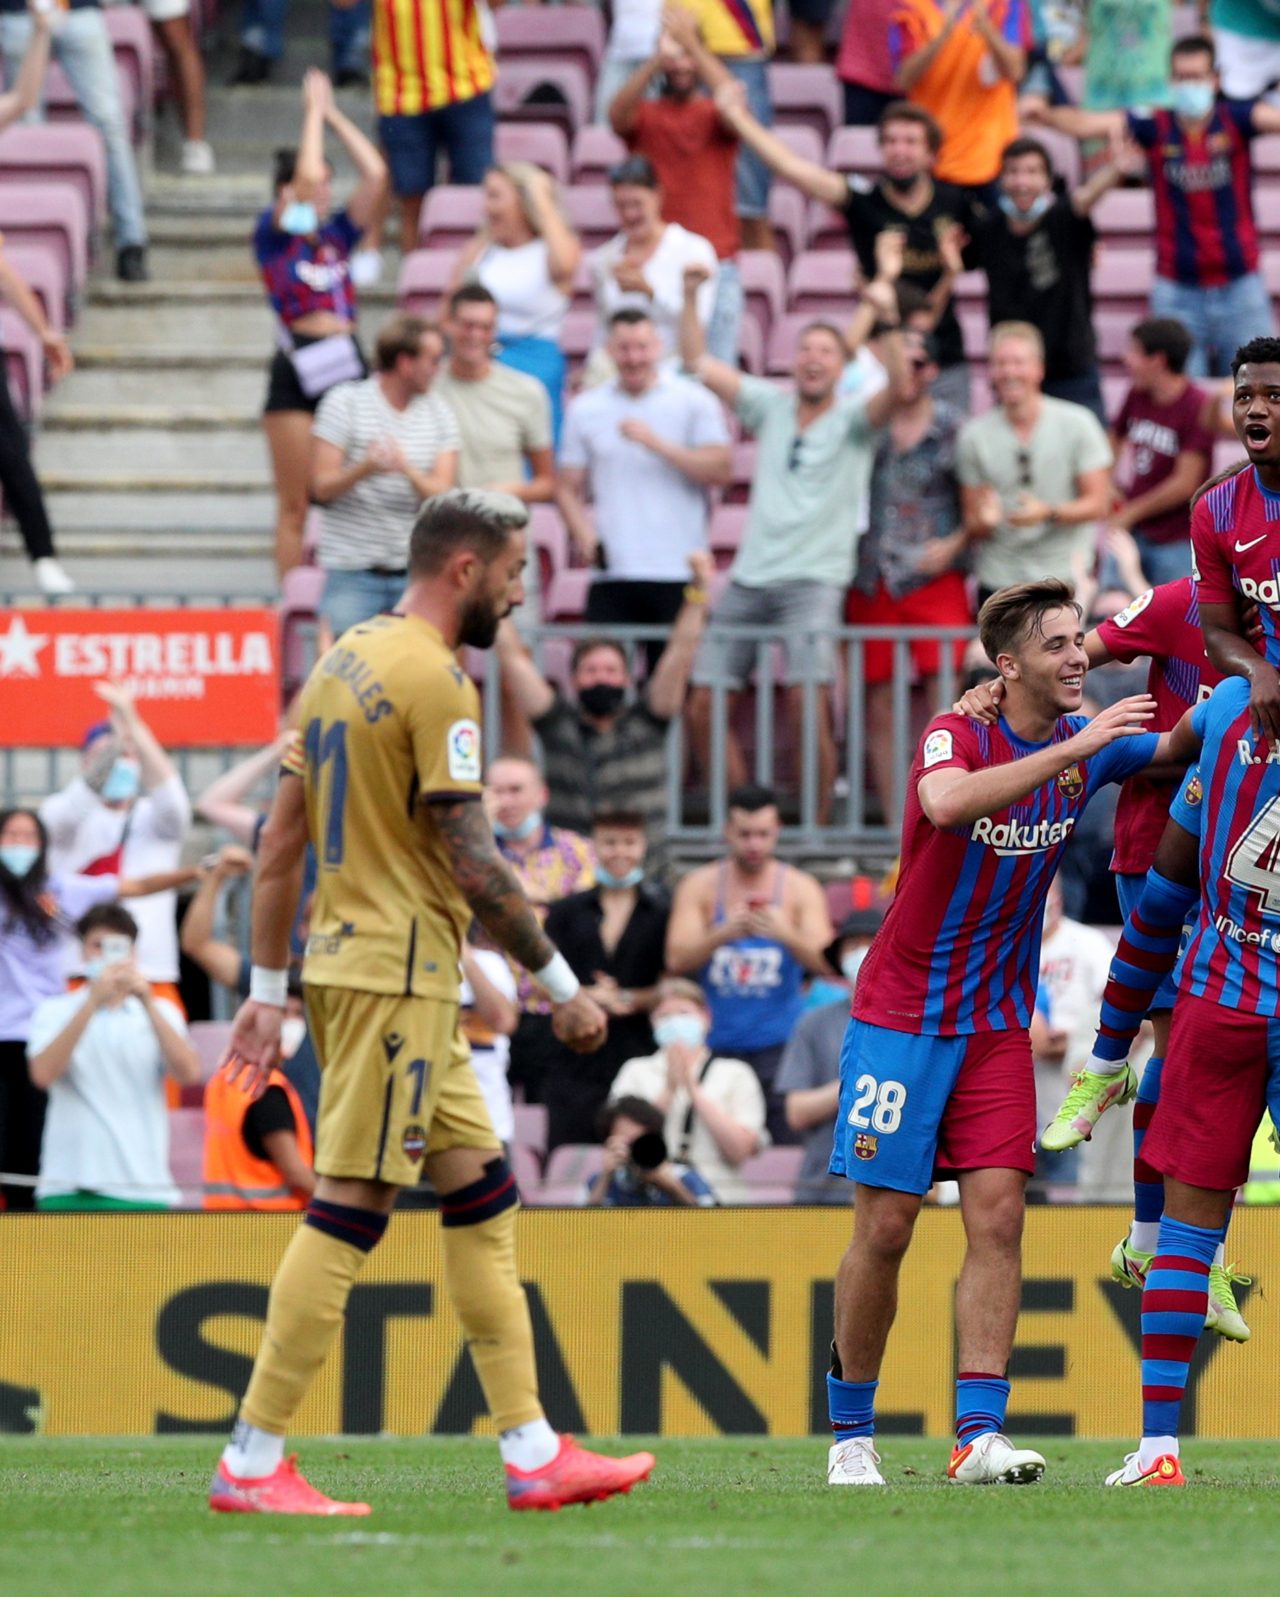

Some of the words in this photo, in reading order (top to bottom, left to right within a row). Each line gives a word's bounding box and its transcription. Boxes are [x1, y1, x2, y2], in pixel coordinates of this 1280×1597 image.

[54, 632, 273, 676] ESTRELLA
[322, 647, 394, 724] ORALES
[1237, 739, 1262, 766] R.
[304, 716, 348, 866] 11
[847, 1073, 907, 1135] 28
[154, 1281, 1252, 1437] STANLEY
